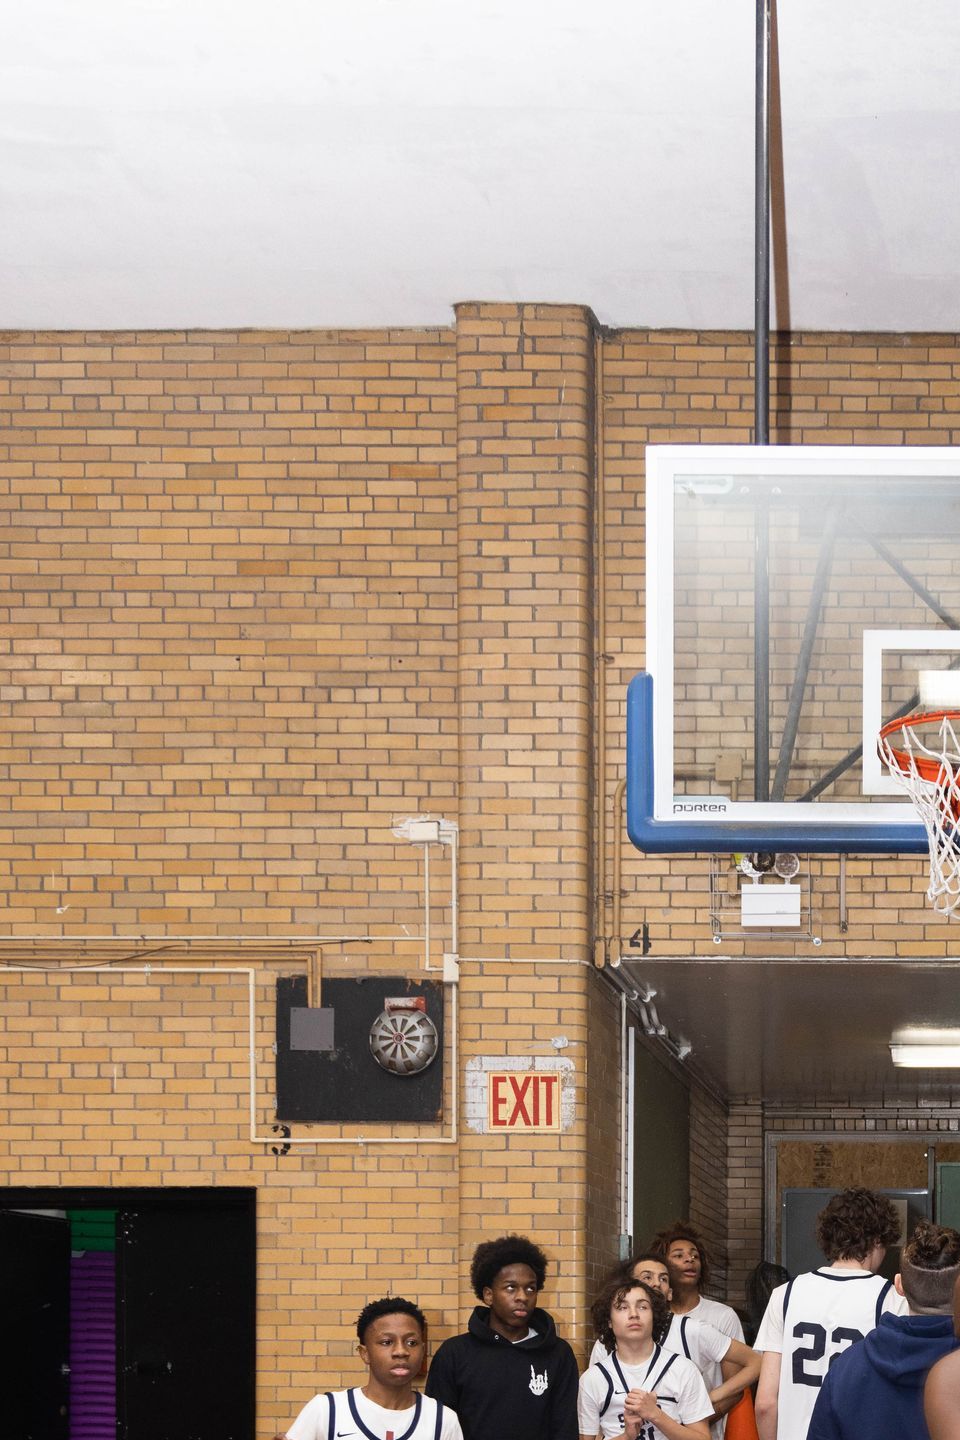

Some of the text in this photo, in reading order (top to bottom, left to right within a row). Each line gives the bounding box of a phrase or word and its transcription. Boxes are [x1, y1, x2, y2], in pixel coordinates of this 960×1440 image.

[629, 923, 652, 955] 4
[492, 1076, 558, 1126] EXIT
[271, 1125, 291, 1155] 3
